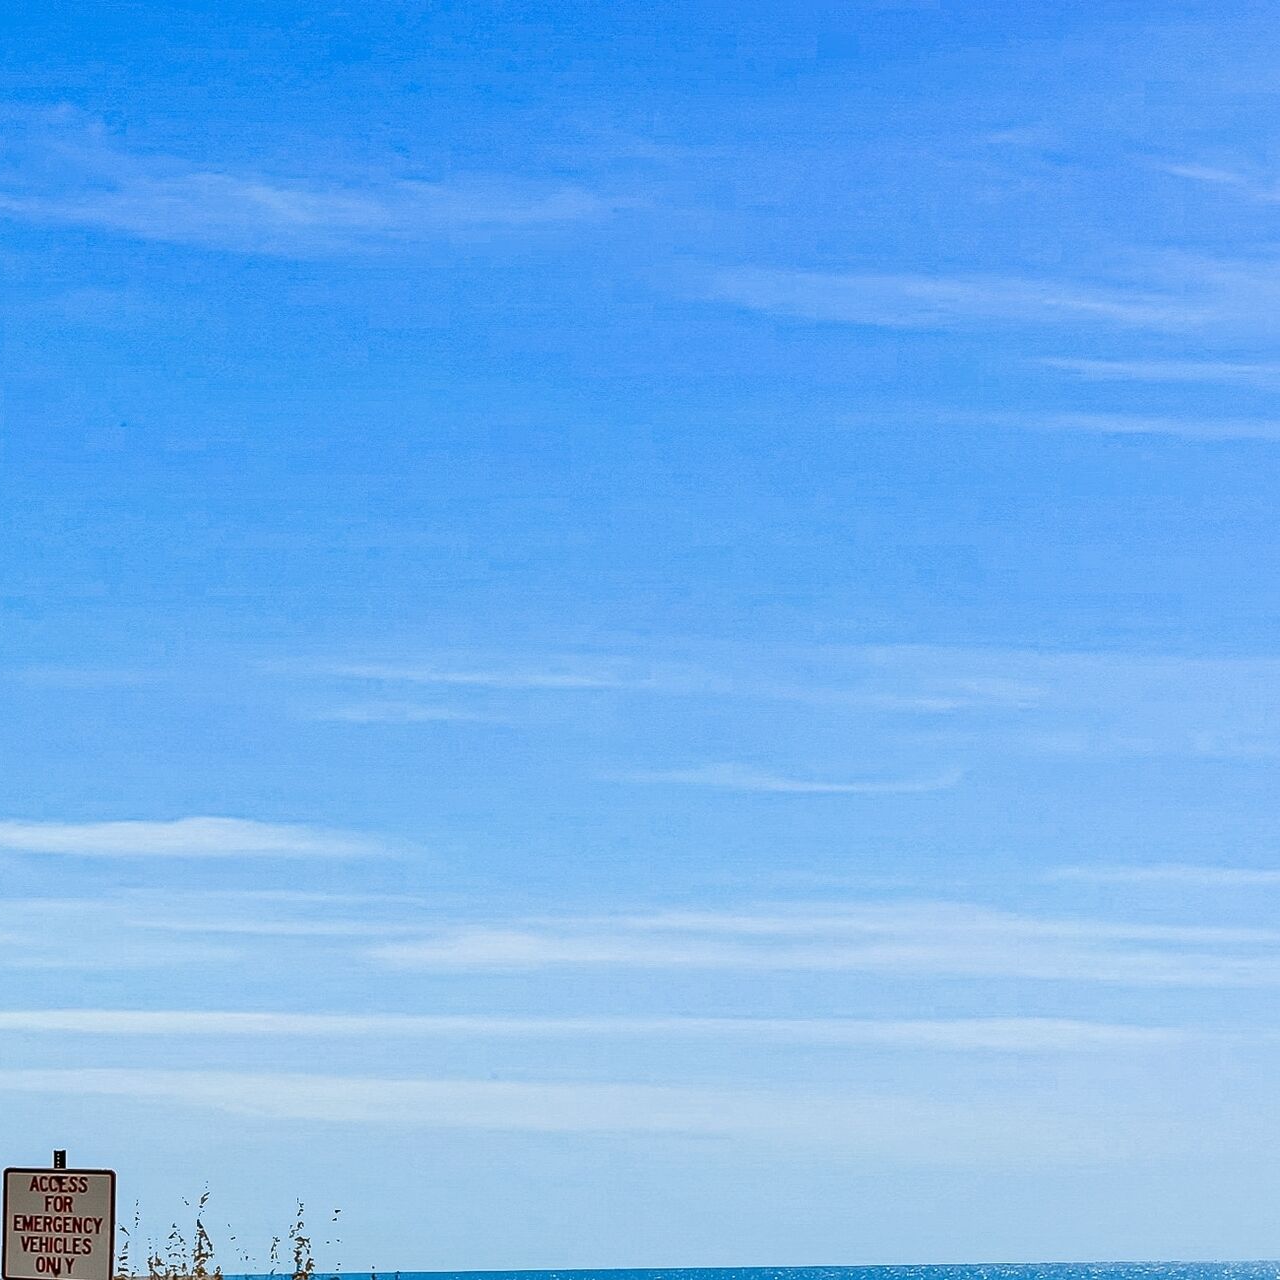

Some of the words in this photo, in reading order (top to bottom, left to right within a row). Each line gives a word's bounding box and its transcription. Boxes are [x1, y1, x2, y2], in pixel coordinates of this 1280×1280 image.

[29, 1176, 88, 1193] ACCESS
[45, 1196, 72, 1212] FOR
[14, 1216, 103, 1234] EMERGENCY
[21, 1236, 92, 1254] VEHICLES
